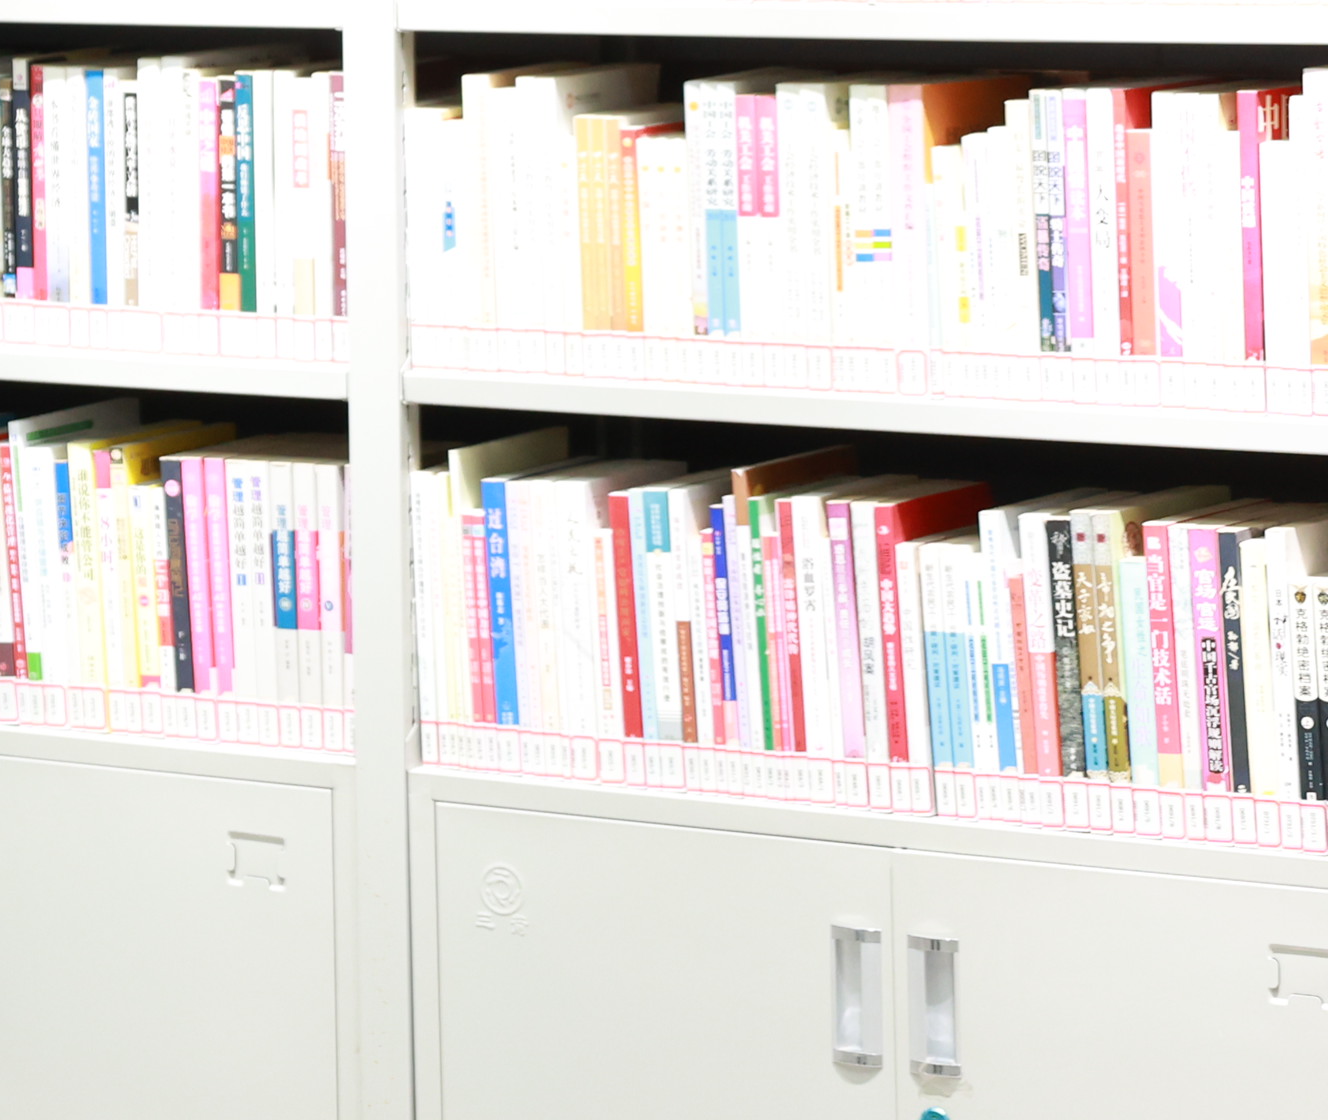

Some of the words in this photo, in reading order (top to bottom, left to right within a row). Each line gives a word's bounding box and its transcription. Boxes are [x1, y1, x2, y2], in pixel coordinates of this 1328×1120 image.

[77, 468, 95, 581] 谁说你不能管公司
[231, 476, 249, 570] 管理越简单越好
[249, 475, 266, 569] 管理越简单越好
[1052, 562, 1076, 637] 盗墓史记
[1147, 554, 1172, 705] 当官是一门技术活
[1194, 569, 1216, 599] 官场
